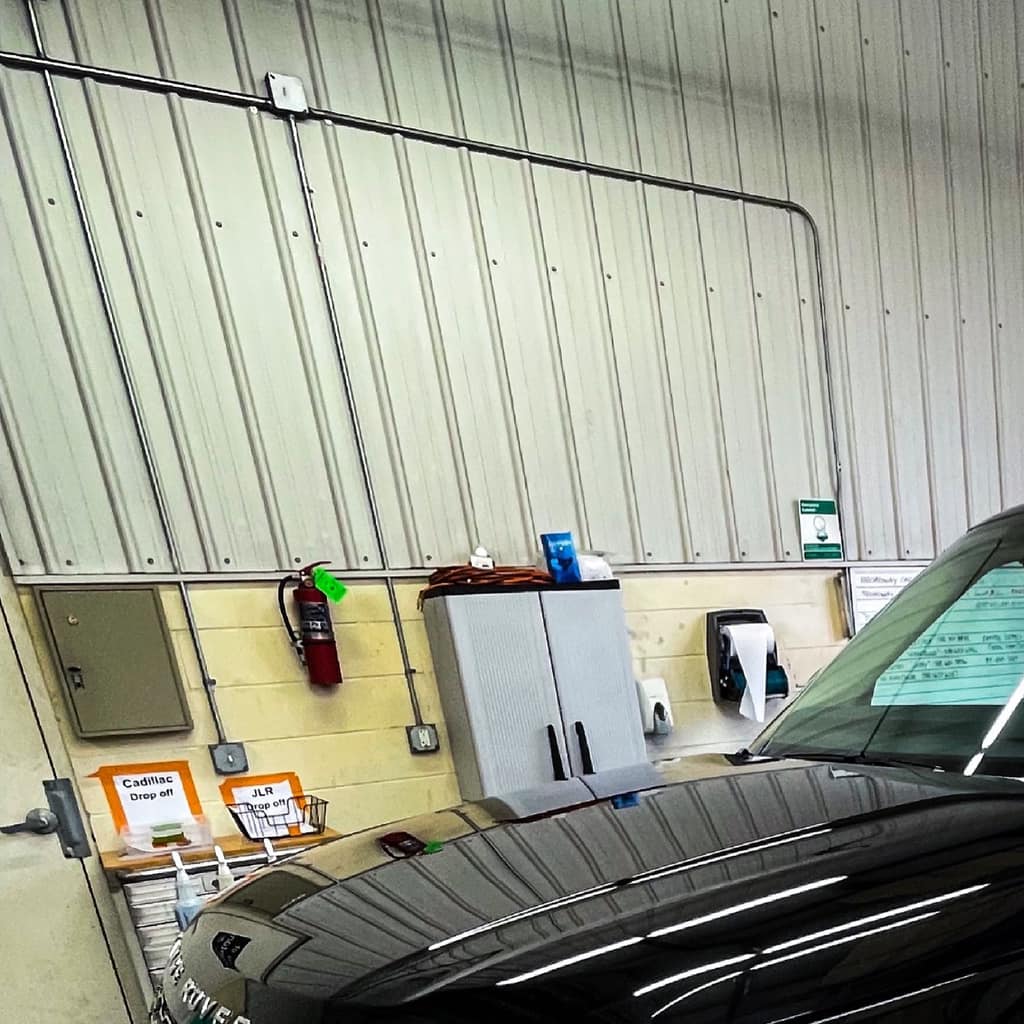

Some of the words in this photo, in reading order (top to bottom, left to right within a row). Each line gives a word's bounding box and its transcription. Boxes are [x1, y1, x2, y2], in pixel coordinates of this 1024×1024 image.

[122, 775, 174, 789] Cadillac
[130, 791, 157, 801] Drop
[159, 788, 174, 798] off
[251, 786, 274, 798] JLR
[272, 798, 286, 808] off
